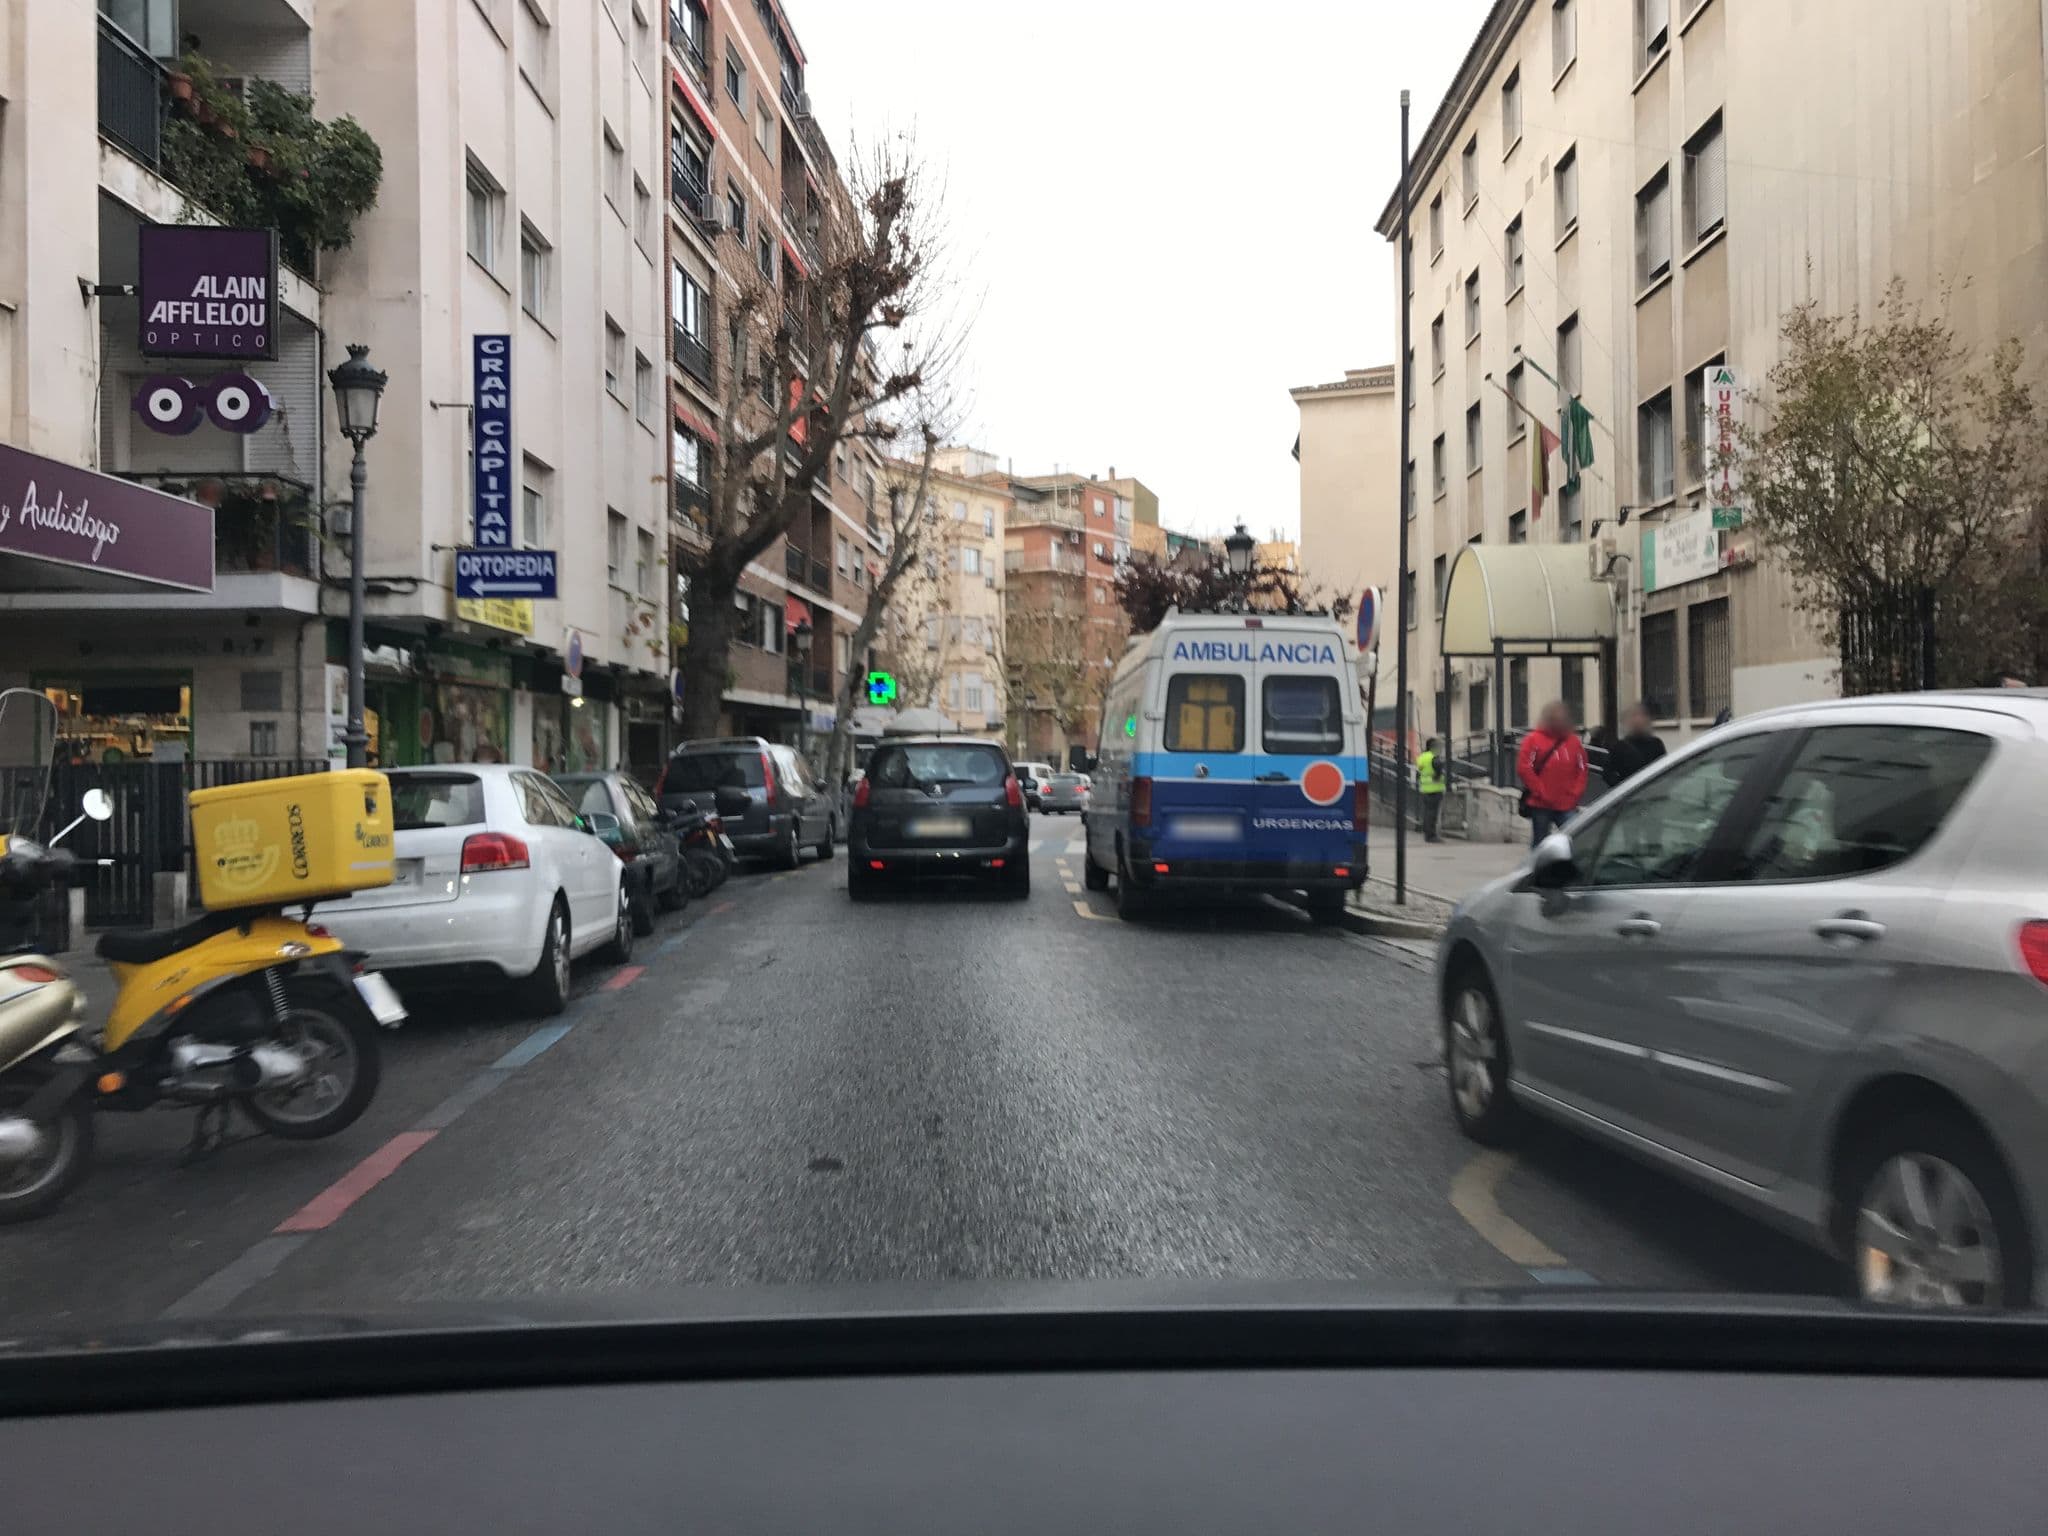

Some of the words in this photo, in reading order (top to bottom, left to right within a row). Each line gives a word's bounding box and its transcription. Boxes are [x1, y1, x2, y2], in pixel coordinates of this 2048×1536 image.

[191, 275, 265, 299] ALAIN
[147, 300, 265, 326] AFFLELOU
[147, 331, 265, 347] OPTICO
[480, 339, 507, 409] GRAN
[1717, 390, 1734, 507] URGENIAS
[480, 421, 507, 545] CAPITAN
[20, 480, 120, 562] Audiólogo
[458, 555, 555, 578] ORTOPEDIA
[1173, 641, 1336, 664] AMBULANCIA
[1253, 817, 1354, 831] URGENCIAS
